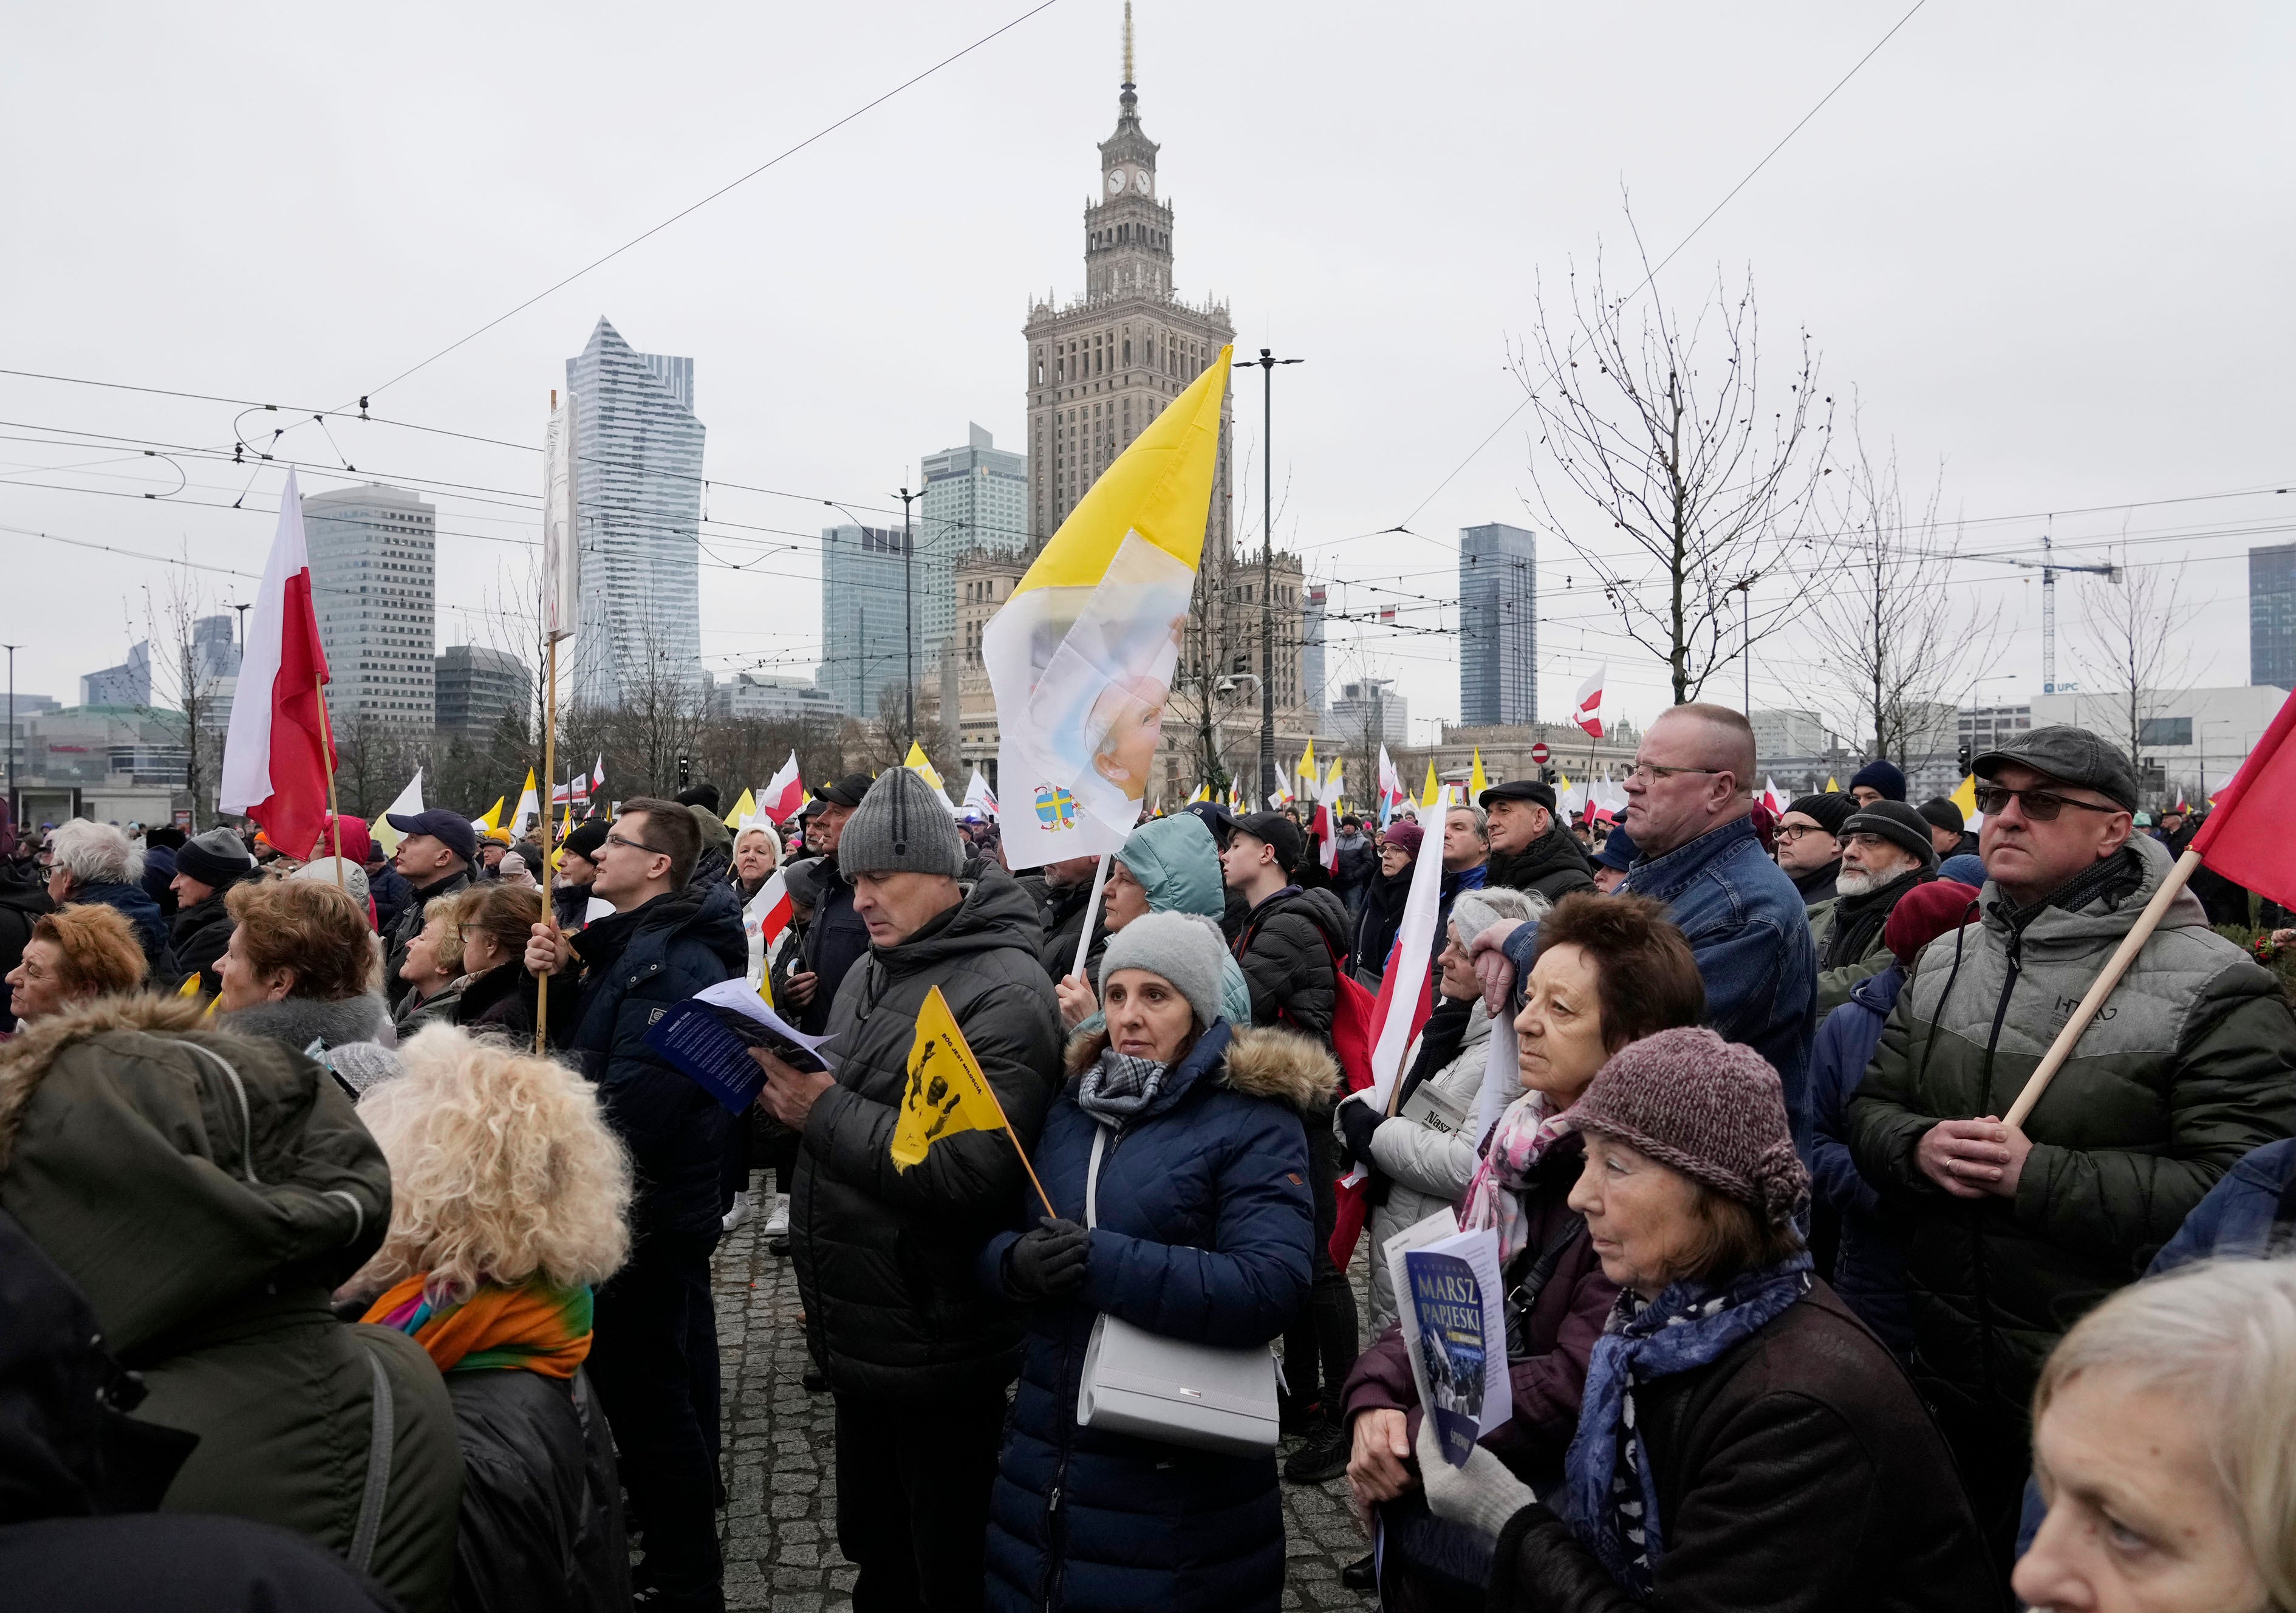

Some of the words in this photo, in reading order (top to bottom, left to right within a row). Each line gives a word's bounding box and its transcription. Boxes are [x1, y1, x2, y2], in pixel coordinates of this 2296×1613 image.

[2057, 682, 2079, 691] UPC
[941, 1033, 953, 1047] BÓG
[951, 1048, 963, 1062] JEST
[1418, 1274, 1478, 1305] MARSZ
[1421, 1303, 1481, 1331] PAPIESKI
